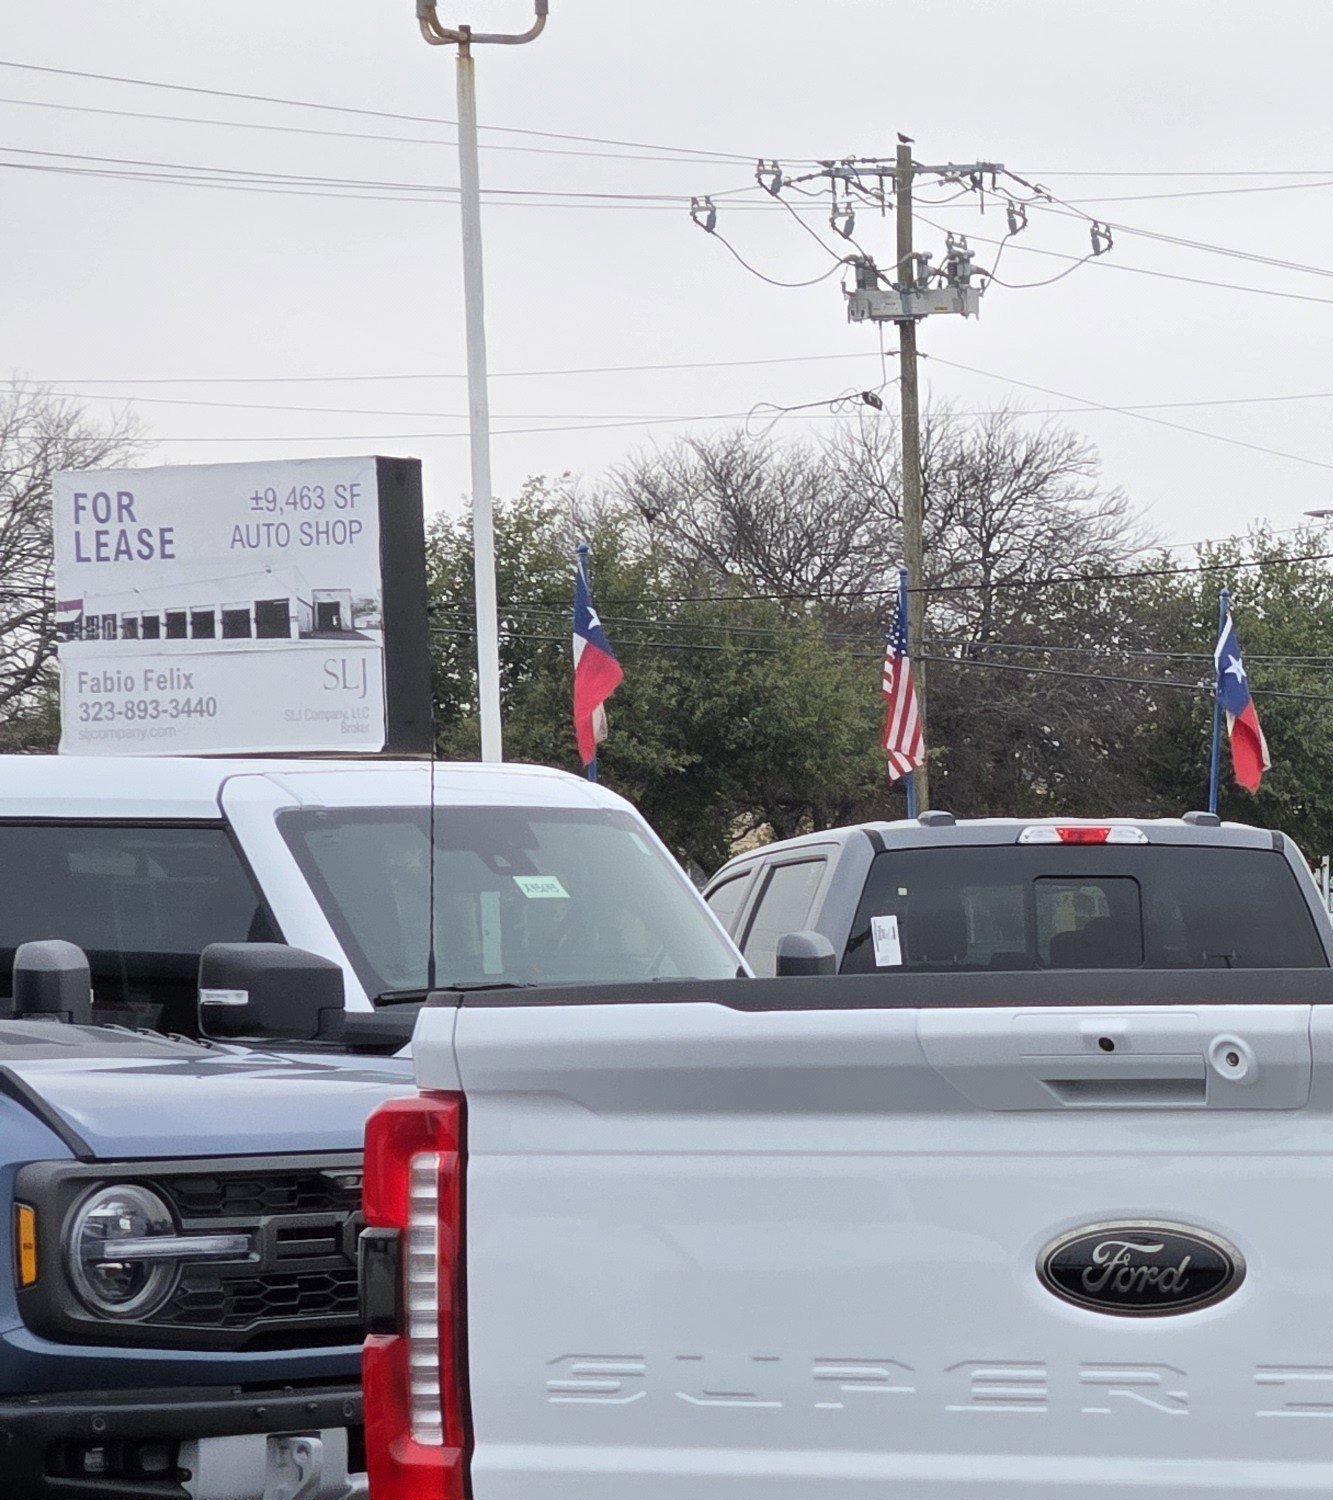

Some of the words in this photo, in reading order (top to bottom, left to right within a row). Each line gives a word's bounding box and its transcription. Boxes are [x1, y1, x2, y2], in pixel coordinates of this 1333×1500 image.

[73, 491, 137, 525] FOR
[250, 485, 326, 514] ±9,463
[334, 483, 362, 509] SF
[74, 527, 176, 563] LEASE
[230, 522, 291, 549] AUTO
[299, 519, 363, 547] SHOP
[77, 671, 135, 694] Fabio
[143, 667, 194, 692] Felix
[323, 657, 368, 699] SLJ
[79, 696, 218, 723] 323-893-3440
[351, 706, 370, 720] LLC
[1082, 1240, 1192, 1294] Ford
[546, 1353, 1191, 1415] SUPER
